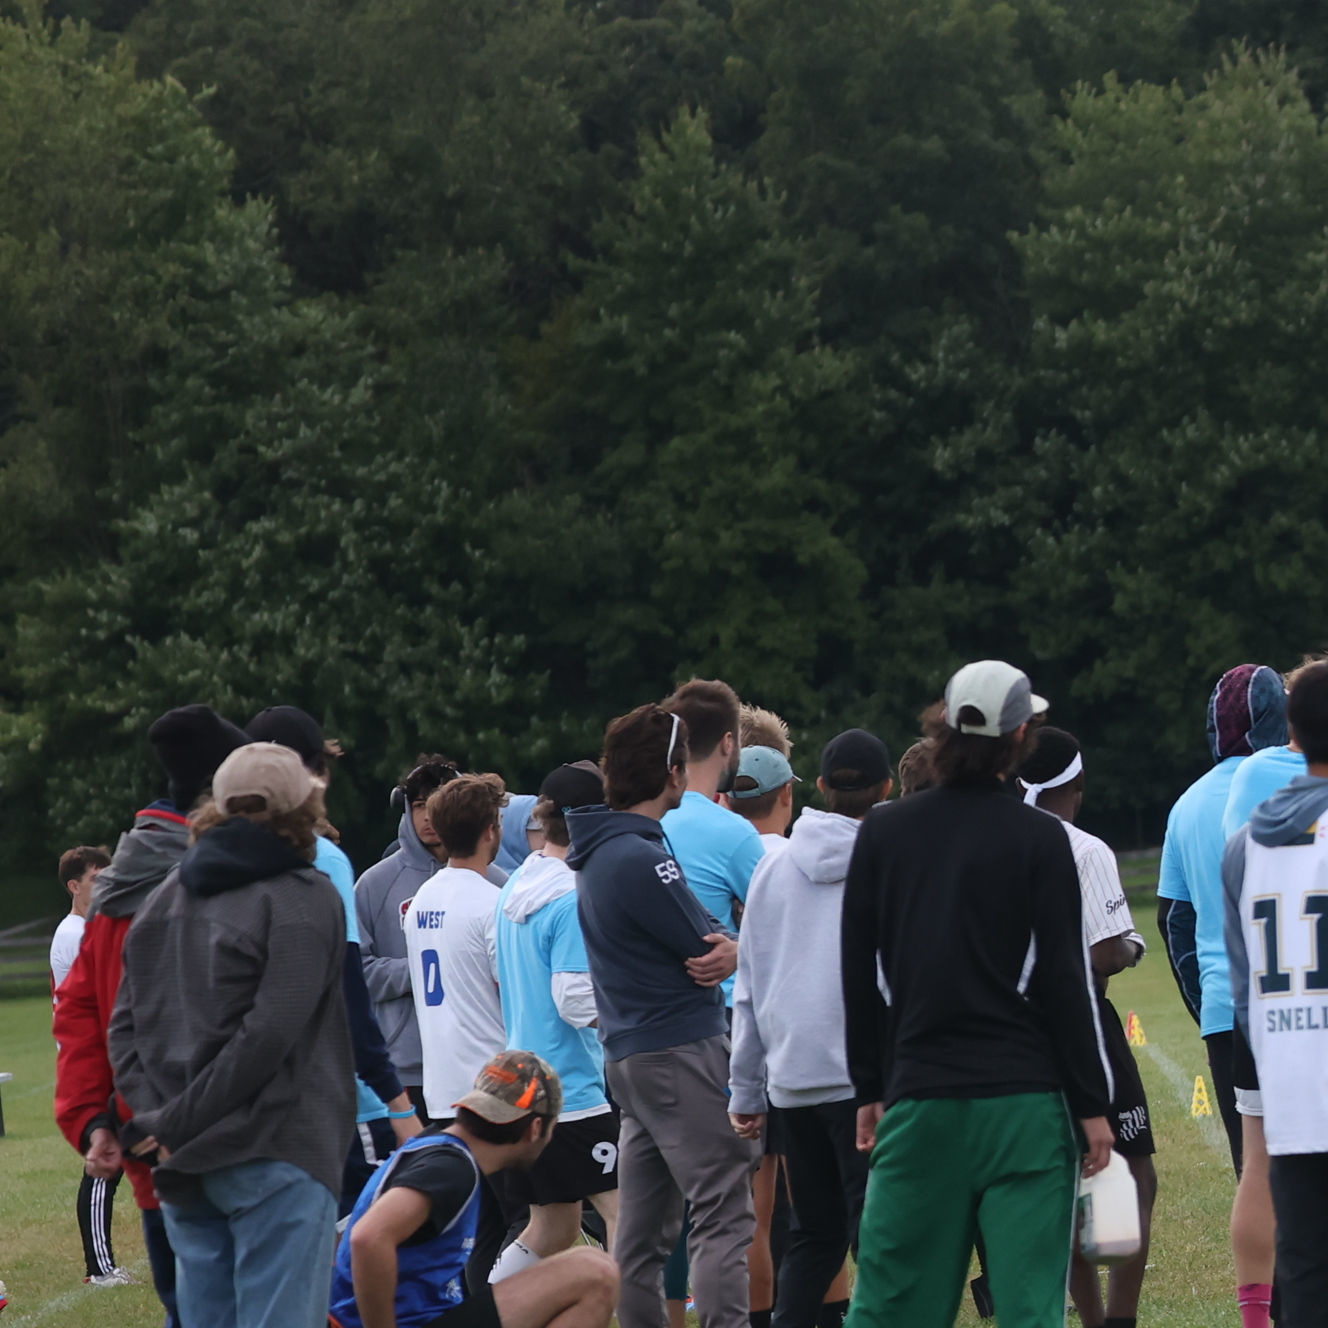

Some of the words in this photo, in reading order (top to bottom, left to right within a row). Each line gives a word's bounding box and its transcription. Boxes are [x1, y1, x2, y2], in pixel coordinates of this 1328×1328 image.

[416, 911, 446, 929] WEST
[421, 949, 444, 1007] 0
[591, 1141, 618, 1175] 9
